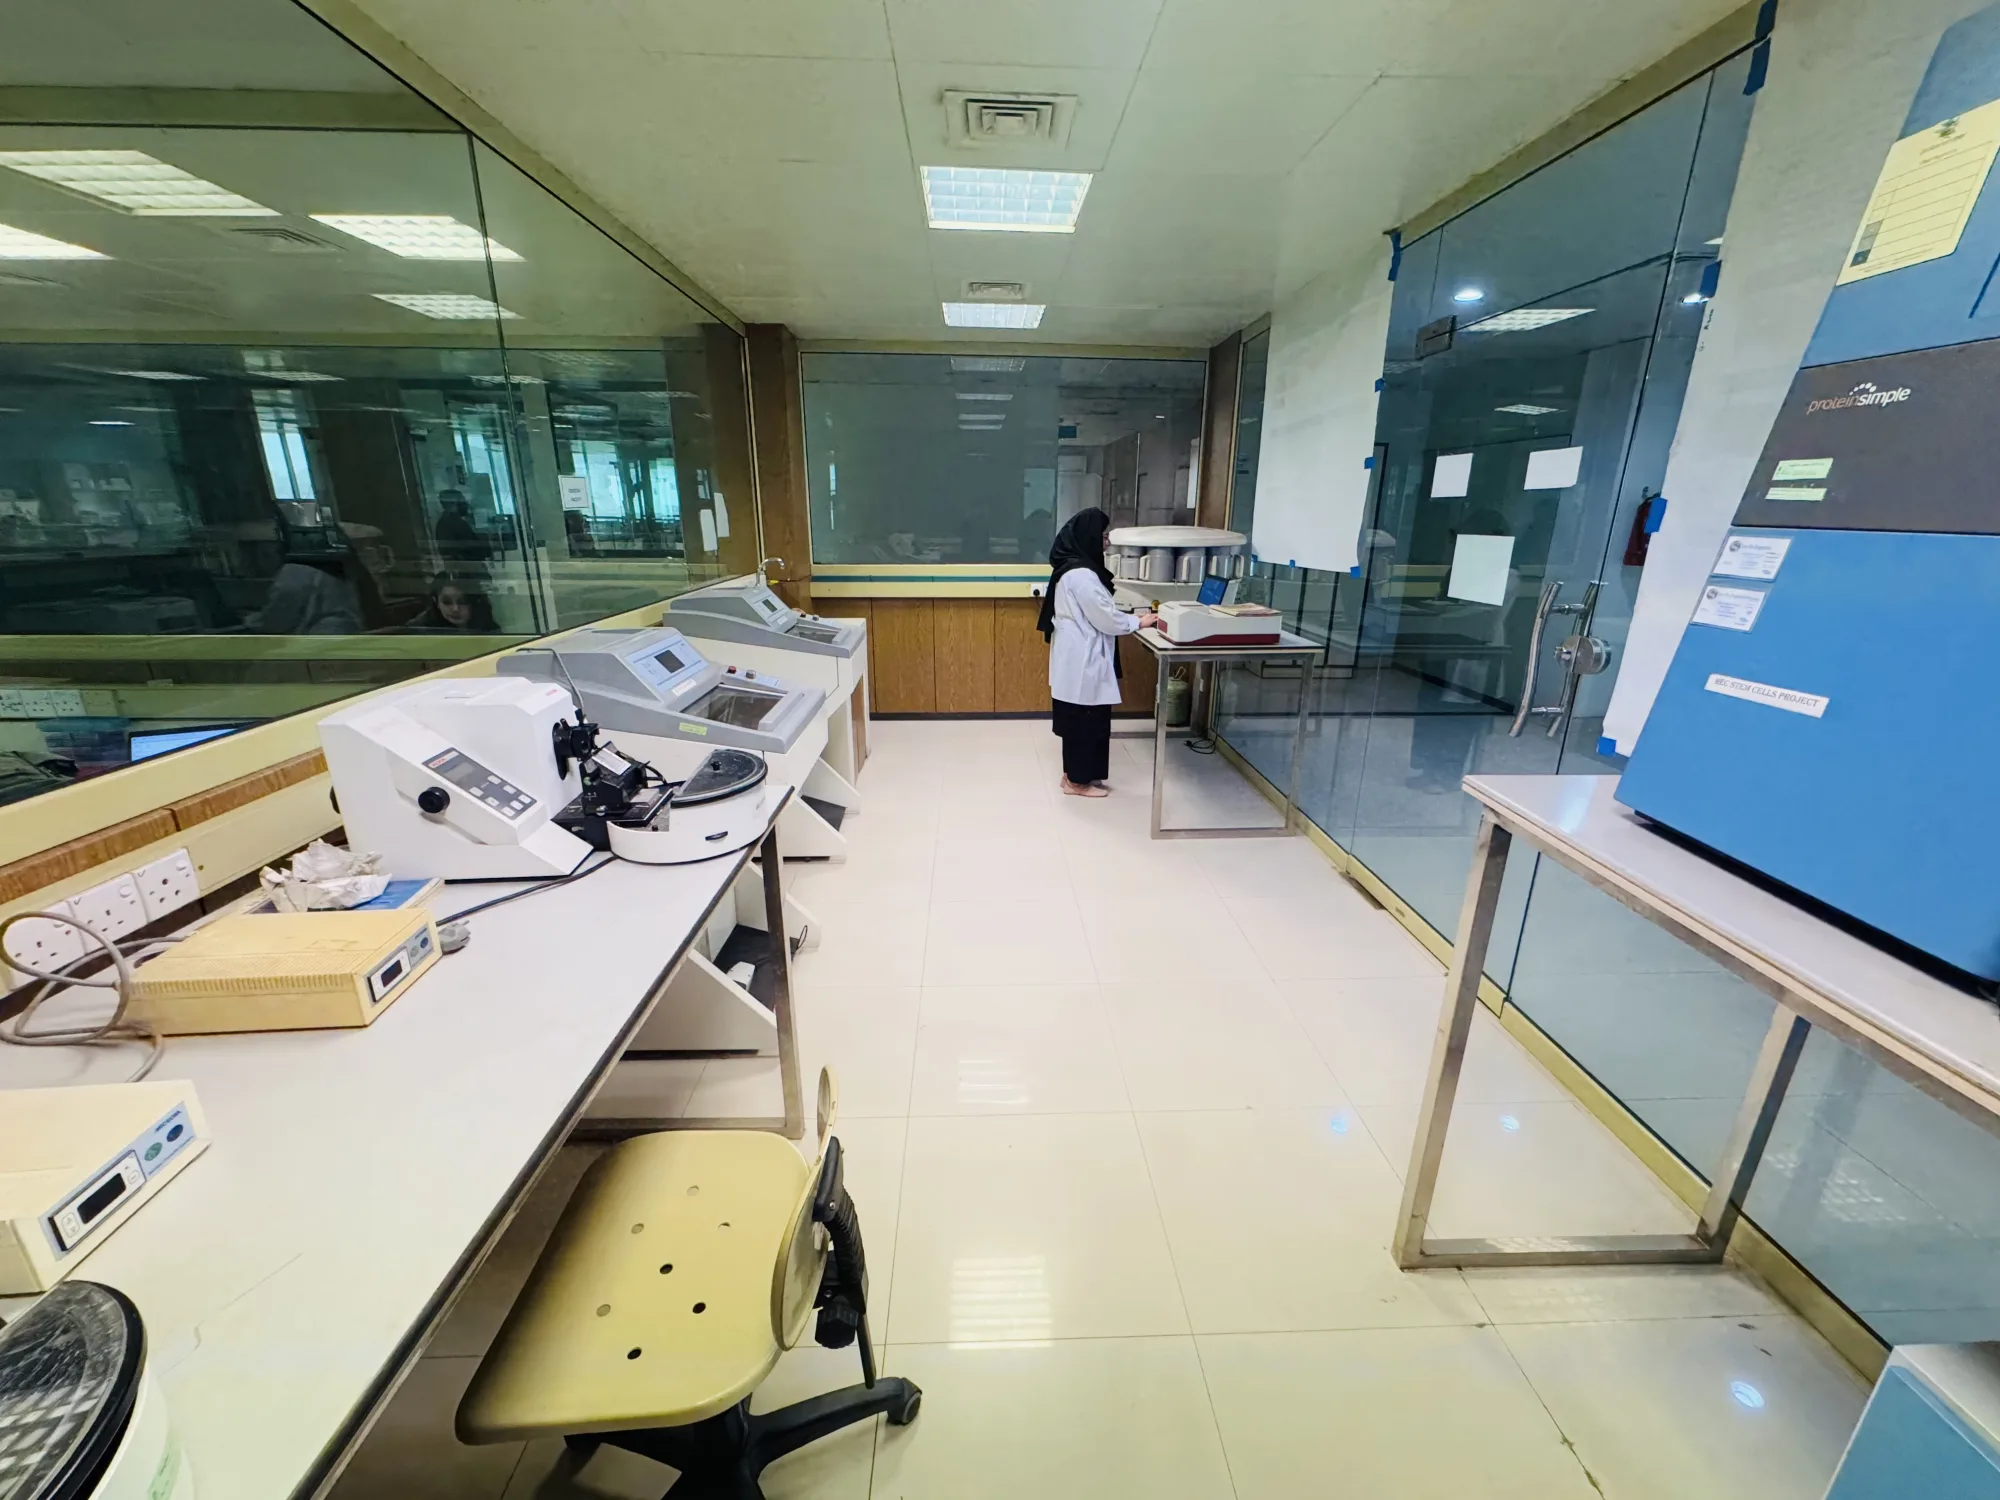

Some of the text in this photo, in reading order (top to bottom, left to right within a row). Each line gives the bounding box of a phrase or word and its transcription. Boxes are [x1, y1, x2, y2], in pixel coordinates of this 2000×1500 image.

[1729, 681, 1752, 692] STEM
[1752, 686, 1778, 698] CELLS
[1778, 691, 1820, 708] PROJECT
